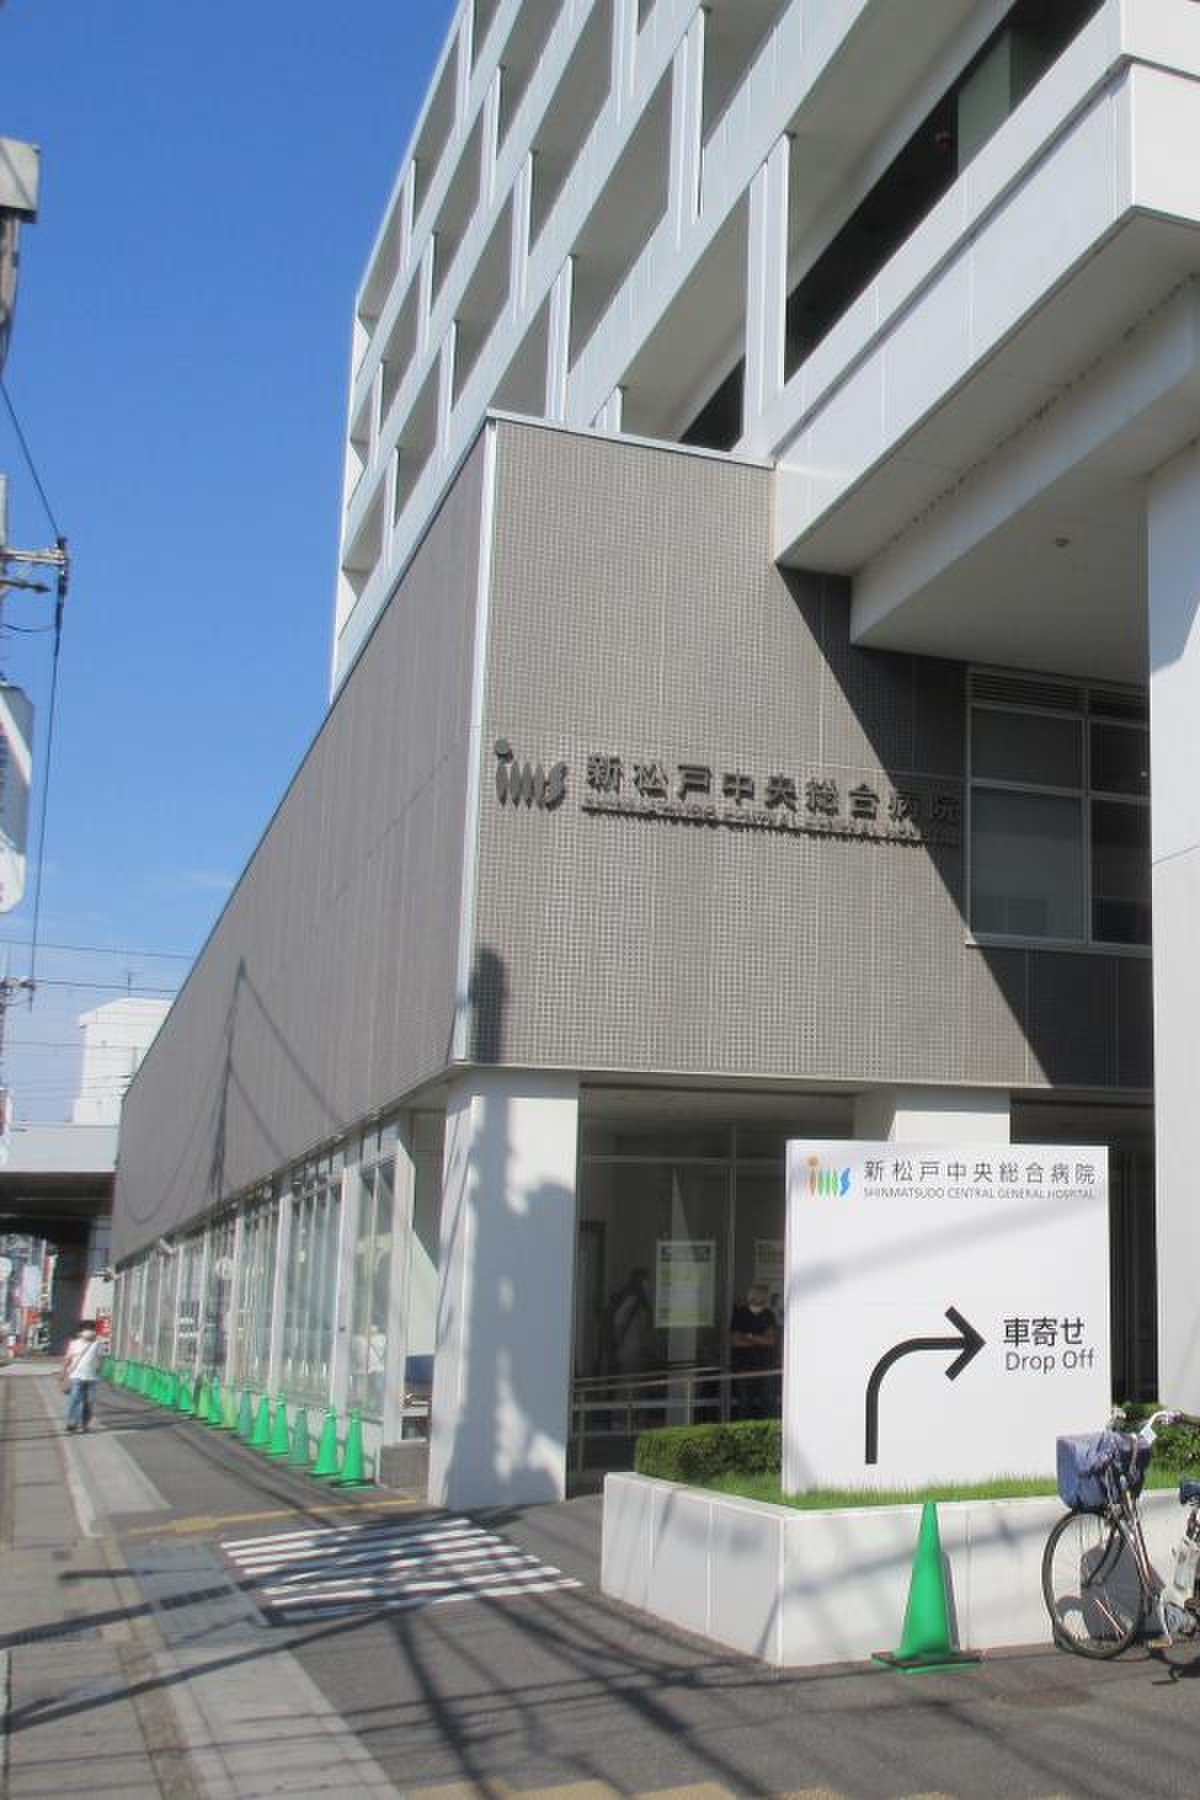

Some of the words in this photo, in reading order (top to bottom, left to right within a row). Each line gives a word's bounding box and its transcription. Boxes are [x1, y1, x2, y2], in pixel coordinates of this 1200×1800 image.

[864, 1159, 1095, 1184] 新松戸中央総合病院
[864, 1187, 944, 1200] SHINMATSUDO
[947, 1187, 993, 1200] CENTRAL
[997, 1187, 1043, 1200] GENERAL
[1047, 1187, 1097, 1201] HOSPITAL
[1003, 1317, 1085, 1347] 車寄せ
[1006, 1351, 1056, 1374] Drop
[1062, 1348, 1094, 1369] Off
